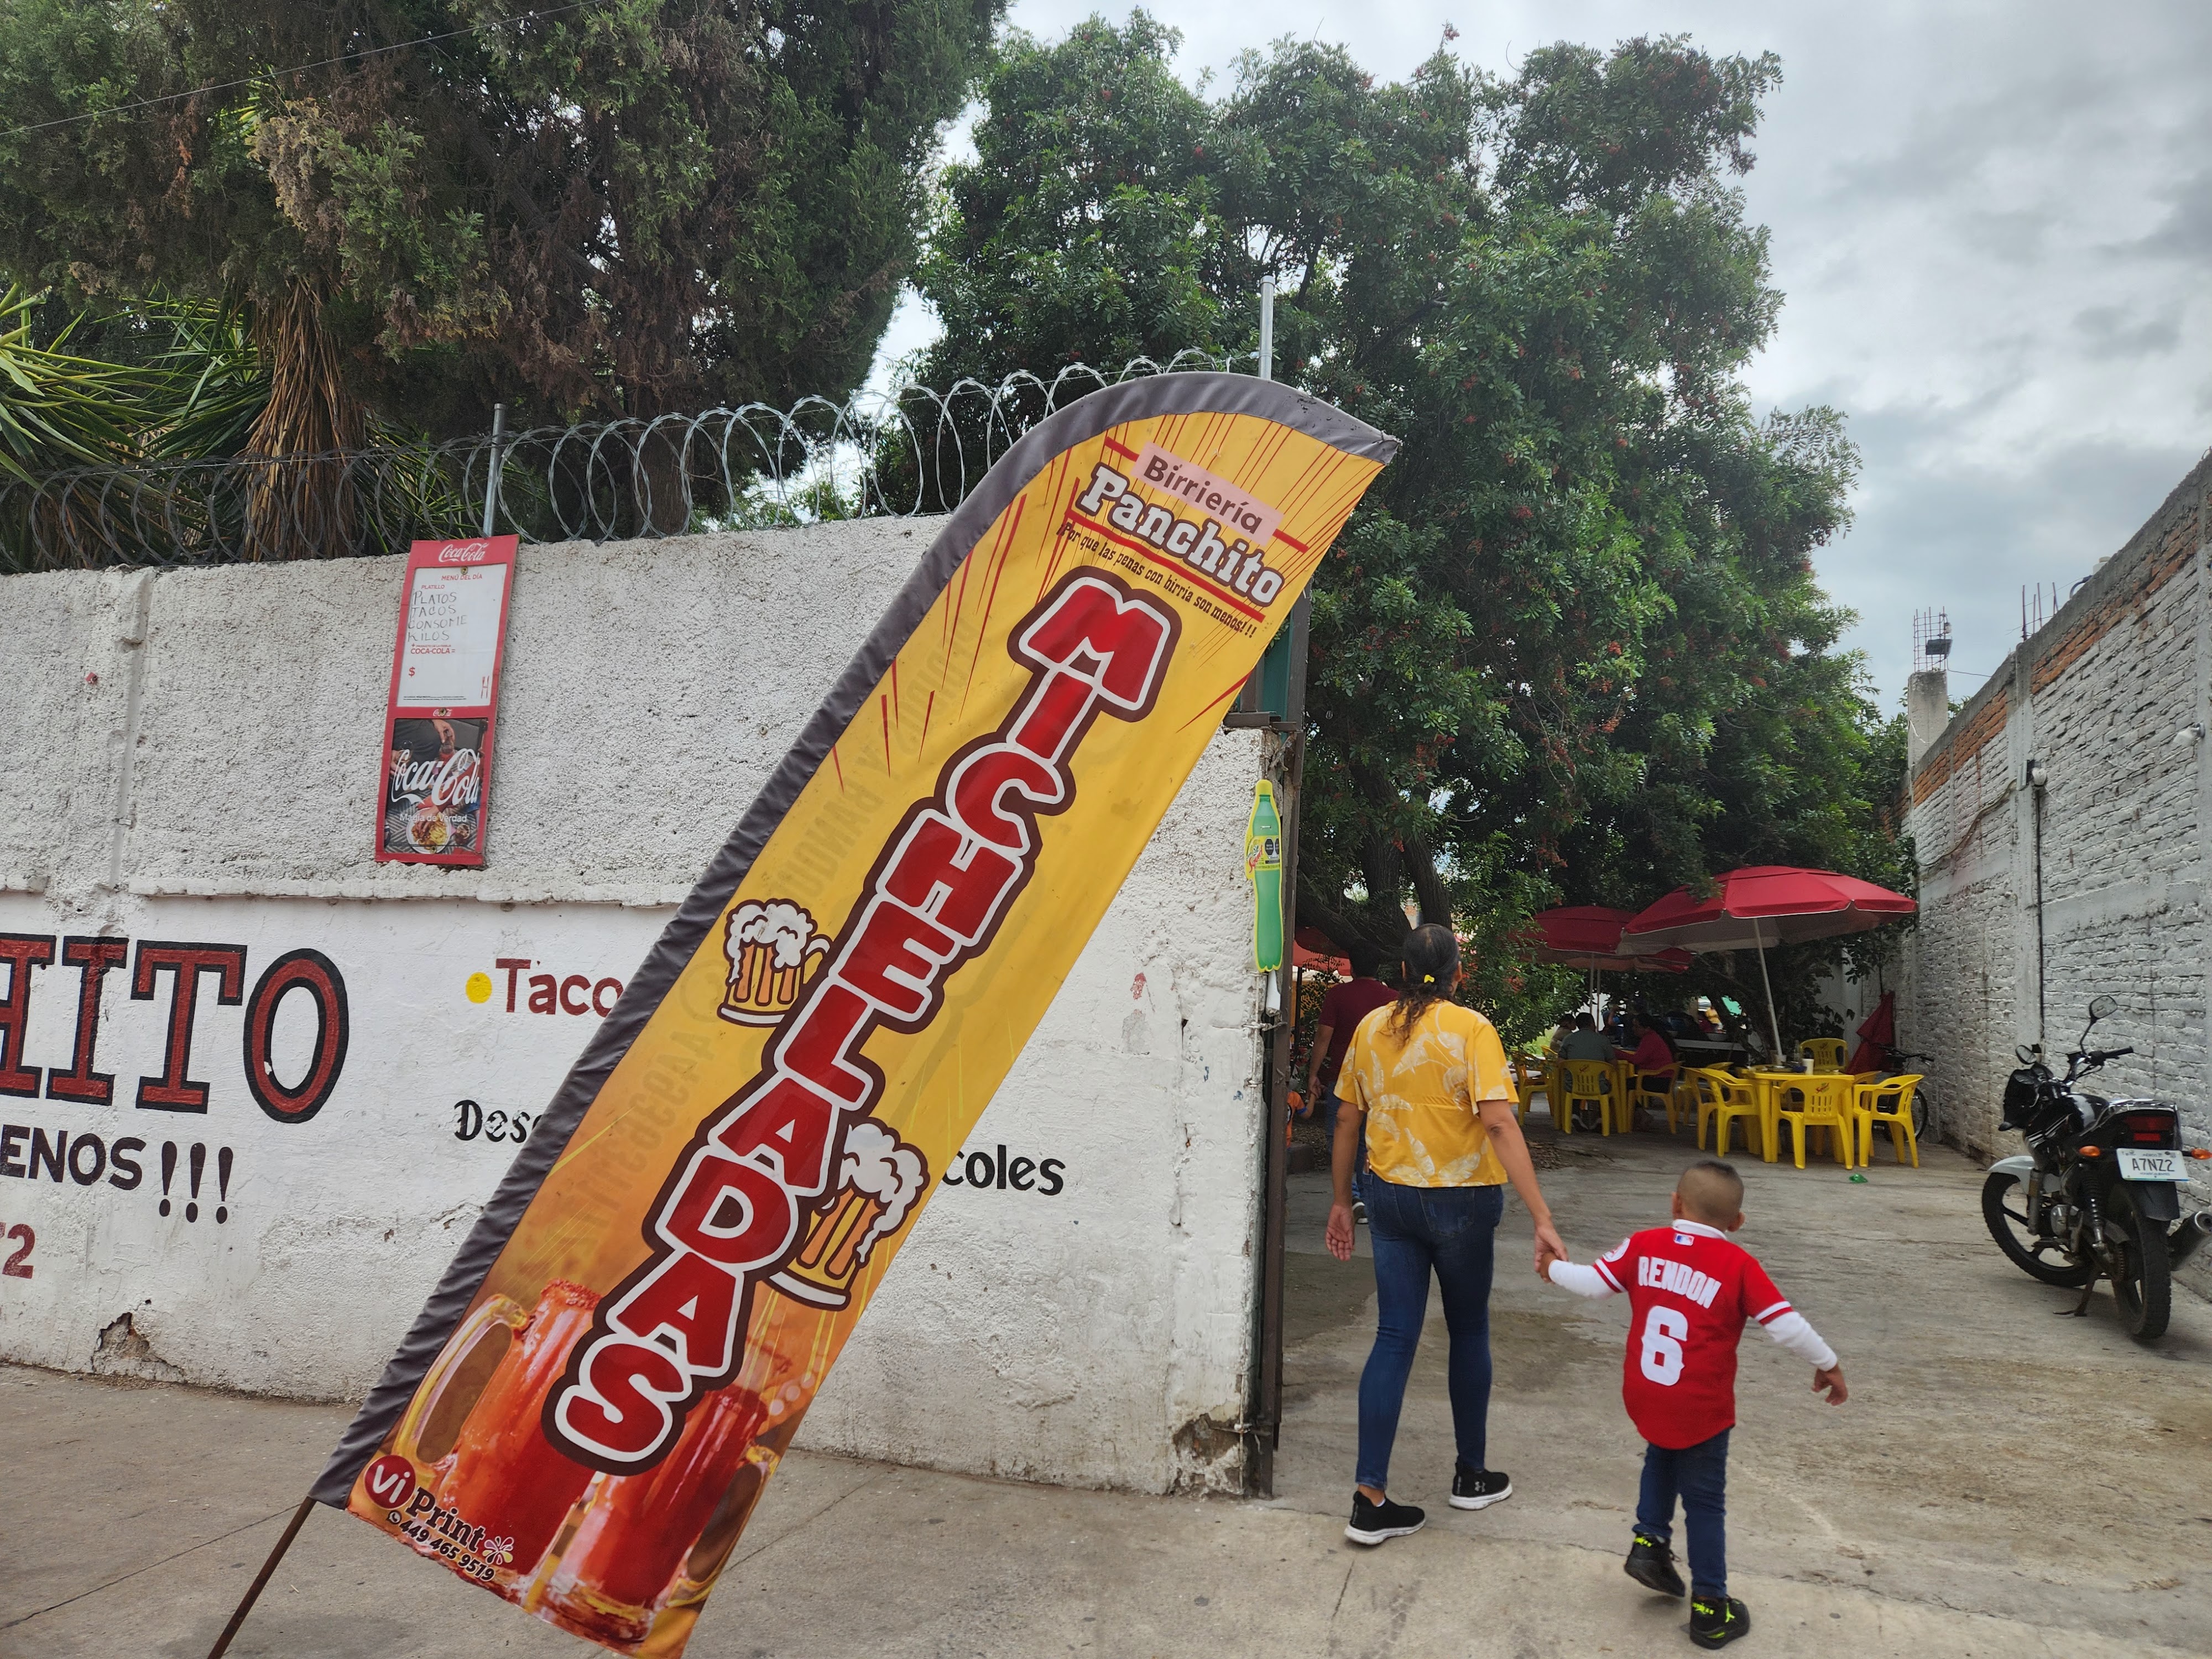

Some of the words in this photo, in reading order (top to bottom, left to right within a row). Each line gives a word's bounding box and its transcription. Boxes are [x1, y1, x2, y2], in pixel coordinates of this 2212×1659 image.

[1143, 455, 1262, 534] Birriería
[439, 542, 489, 562] Coca-Cola
[1076, 462, 1284, 607] Panchito
[414, 590, 458, 606] PLATOS
[1080, 536, 1099, 552] que
[1098, 541, 1117, 561] las
[1116, 551, 1145, 576] penas
[1145, 566, 1164, 585] con
[1163, 575, 1193, 602] birria
[1193, 596, 1213, 614] son
[407, 614, 467, 630] CONSOME
[411, 604, 457, 618] TACOS
[409, 666, 415, 677] $
[400, 814, 425, 823] Magia
[426, 813, 437, 822] de
[553, 575, 1172, 1464] MICHELADAS
[454, 1099, 543, 1143] Des
[2132, 1158, 2175, 1172] A7NZ2
[0, 1222, 35, 1280] 2
[1638, 1256, 1722, 1309] RENDON
[1640, 1305, 1688, 1386] 6
[405, 1486, 486, 1552] Print
[399, 1520, 430, 1543] 449
[430, 1538, 460, 1559] 465
[458, 1554, 494, 1581] 9519
